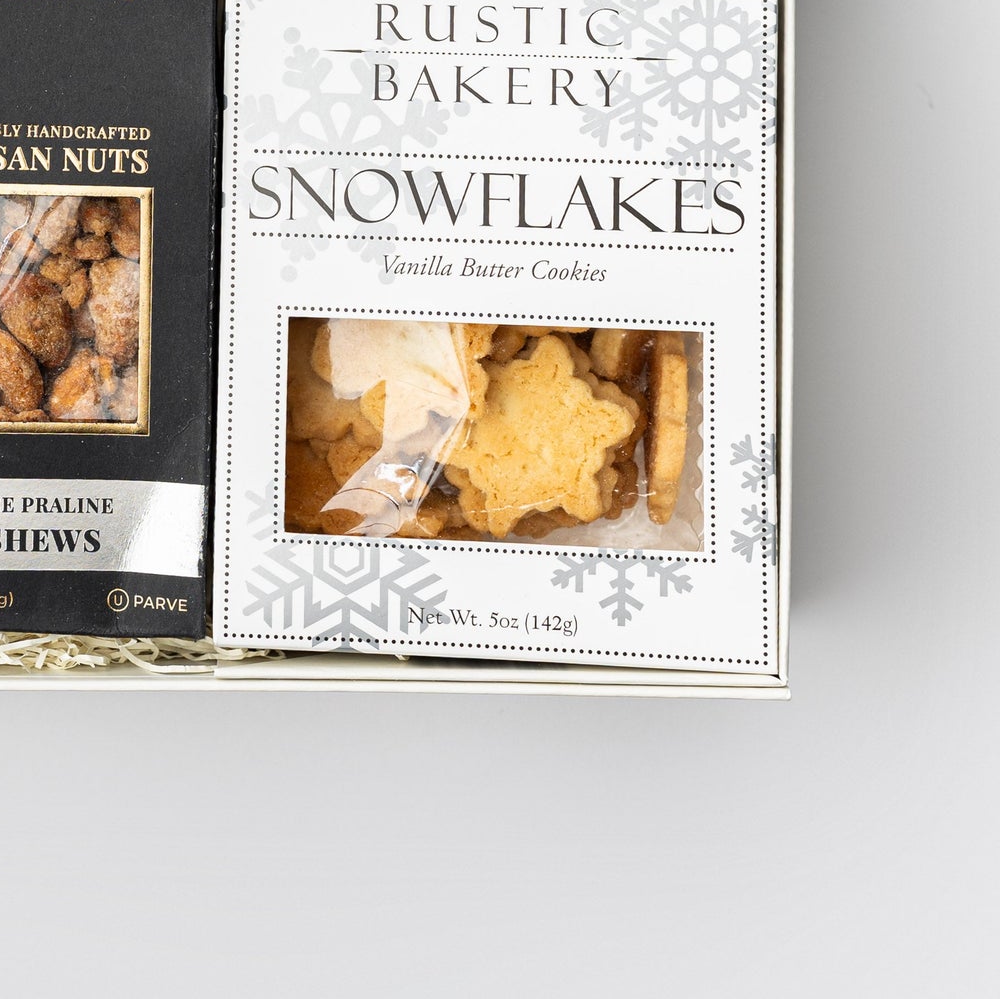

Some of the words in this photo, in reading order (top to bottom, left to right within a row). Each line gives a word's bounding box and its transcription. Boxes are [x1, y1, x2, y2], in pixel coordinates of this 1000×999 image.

[376, 4, 622, 46] RUSTIC
[373, 64, 620, 107] BAKERY
[27, 125, 150, 140] HANDCRAFTED
[63, 148, 148, 174] NUTS
[247, 164, 746, 236] SNOWFLAKES
[384, 255, 452, 276] Vanilla
[460, 258, 524, 278] Butter
[532, 260, 606, 281] Cookies
[22, 498, 113, 514] PRALINE
[133, 595, 188, 612] PARVE
[408, 606, 444, 627] Net
[448, 609, 483, 629] Wt.
[488, 610, 520, 631] 5oz
[524, 612, 579, 637] (142g)
